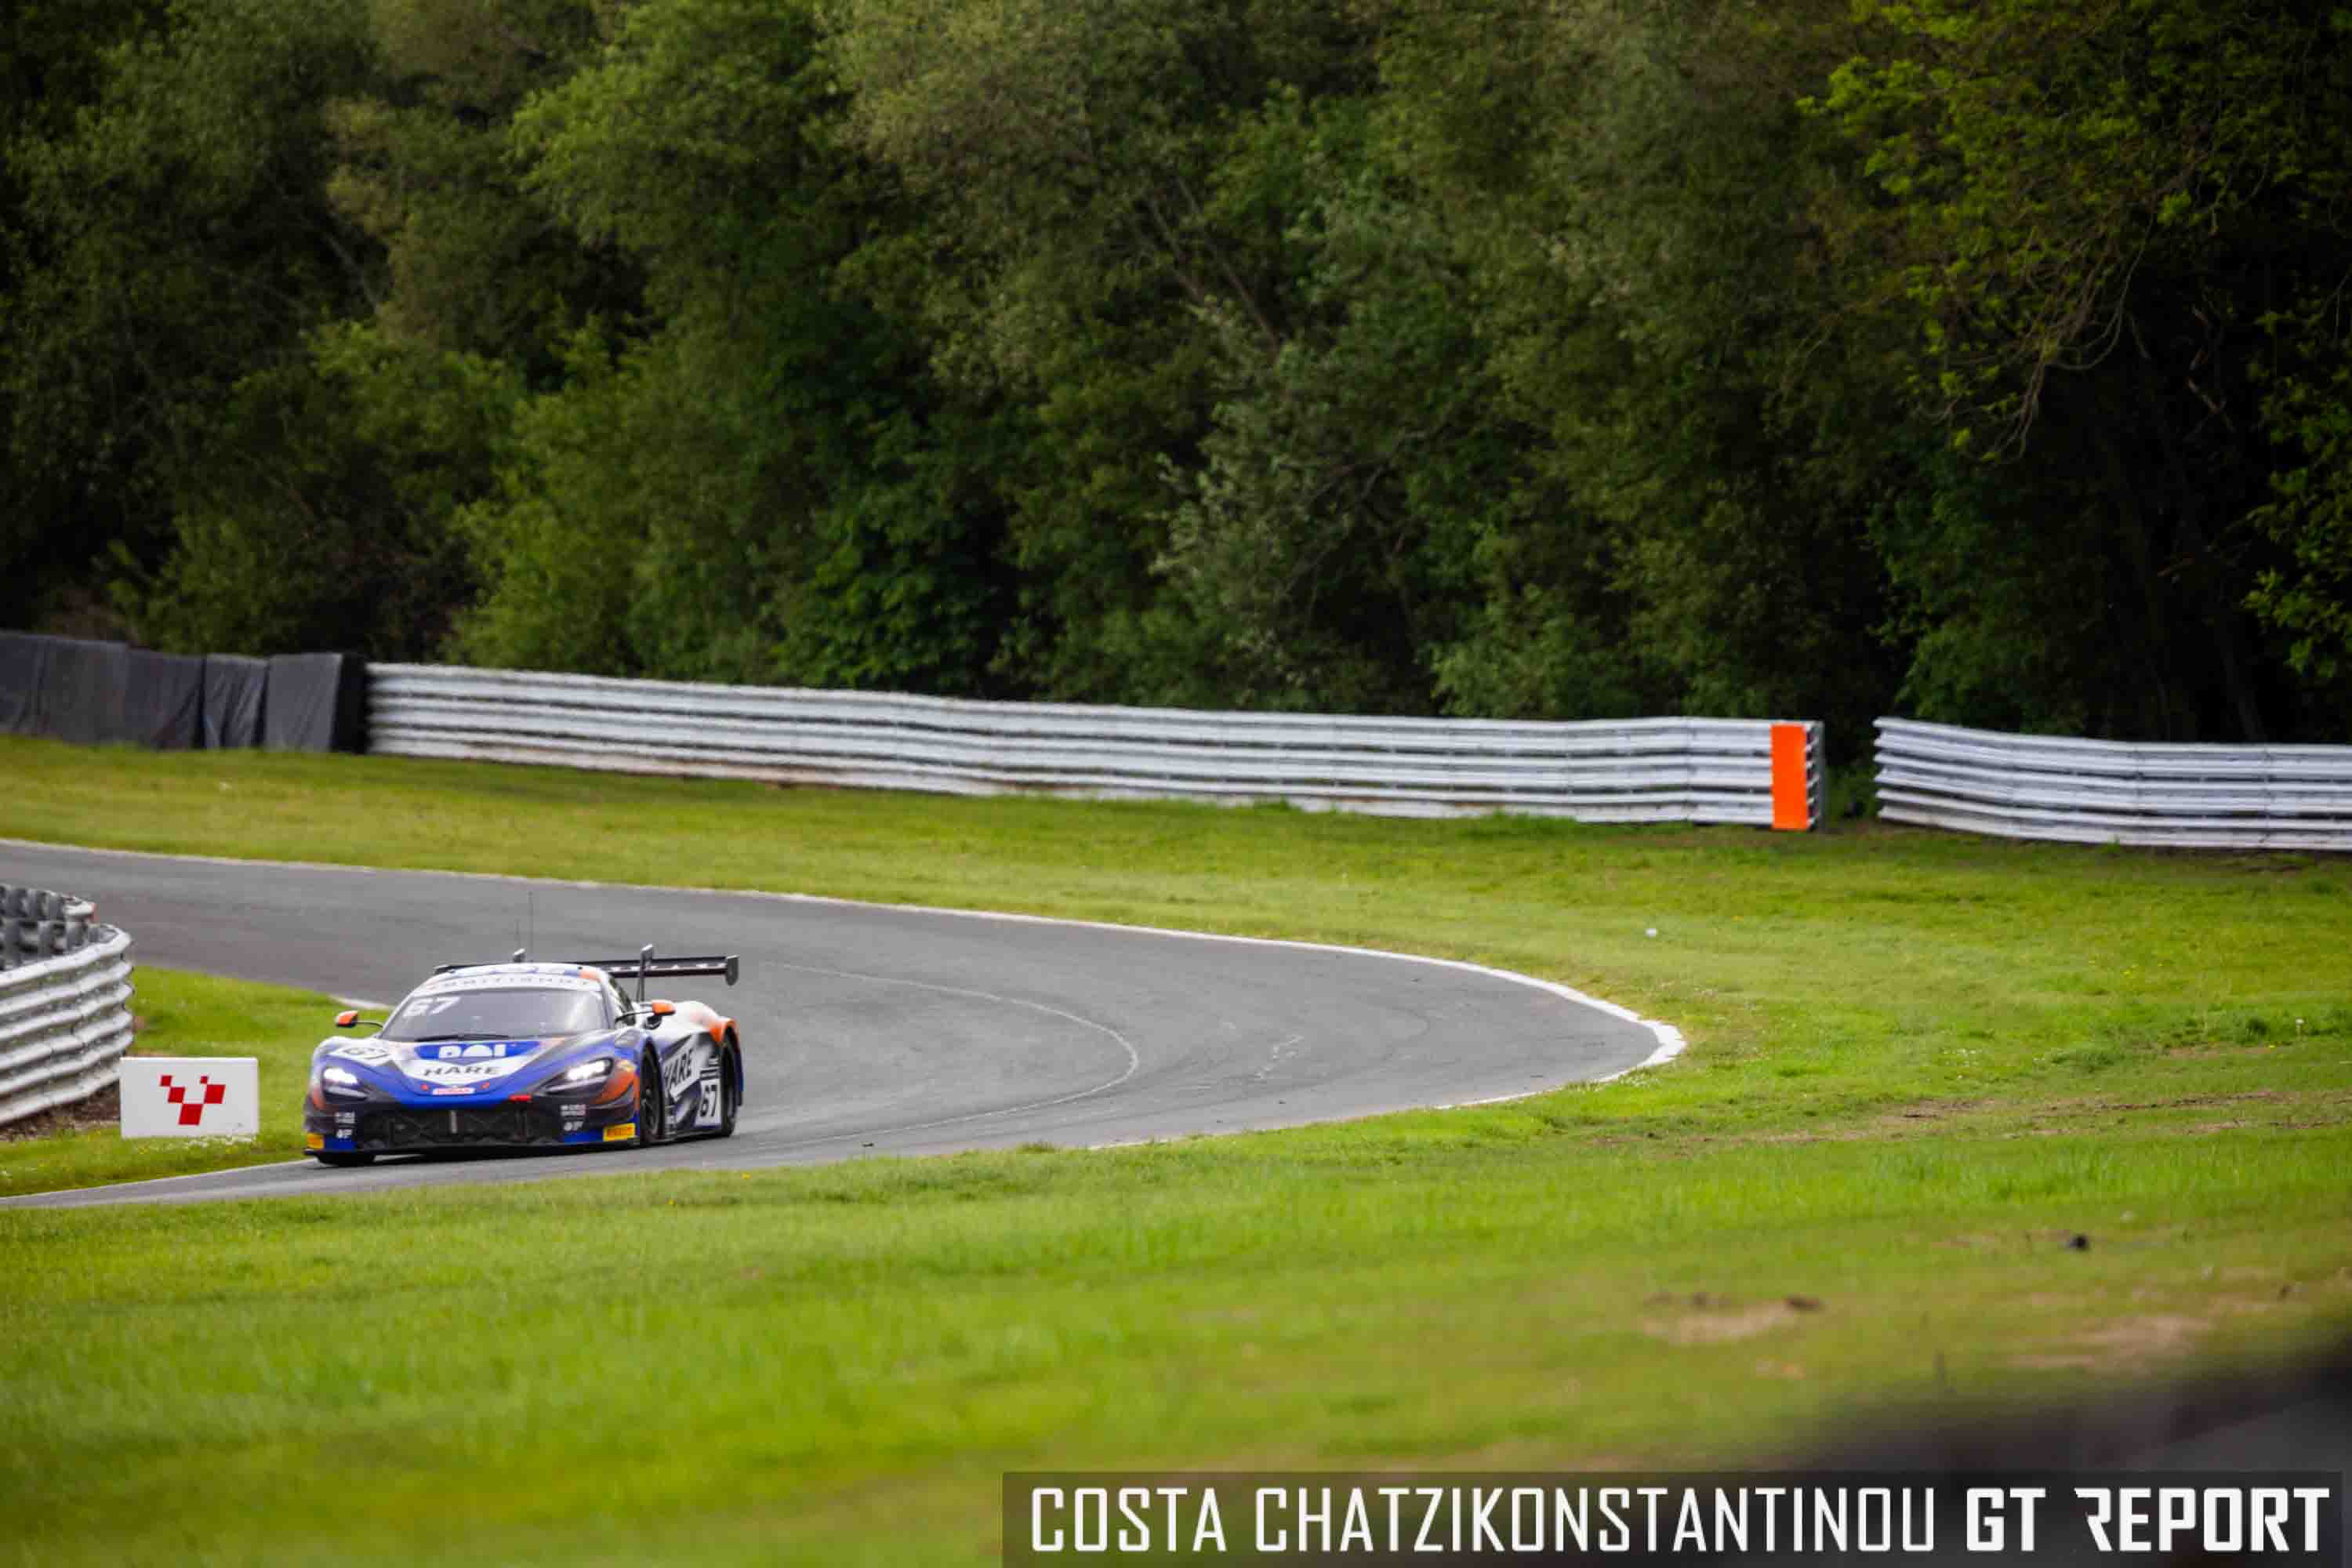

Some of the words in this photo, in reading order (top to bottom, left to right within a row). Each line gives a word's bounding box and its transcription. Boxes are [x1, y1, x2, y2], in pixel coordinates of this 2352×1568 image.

[423, 1067, 500, 1076] HARE
[663, 1048, 693, 1096] HARE
[699, 1084, 717, 1116] 67
